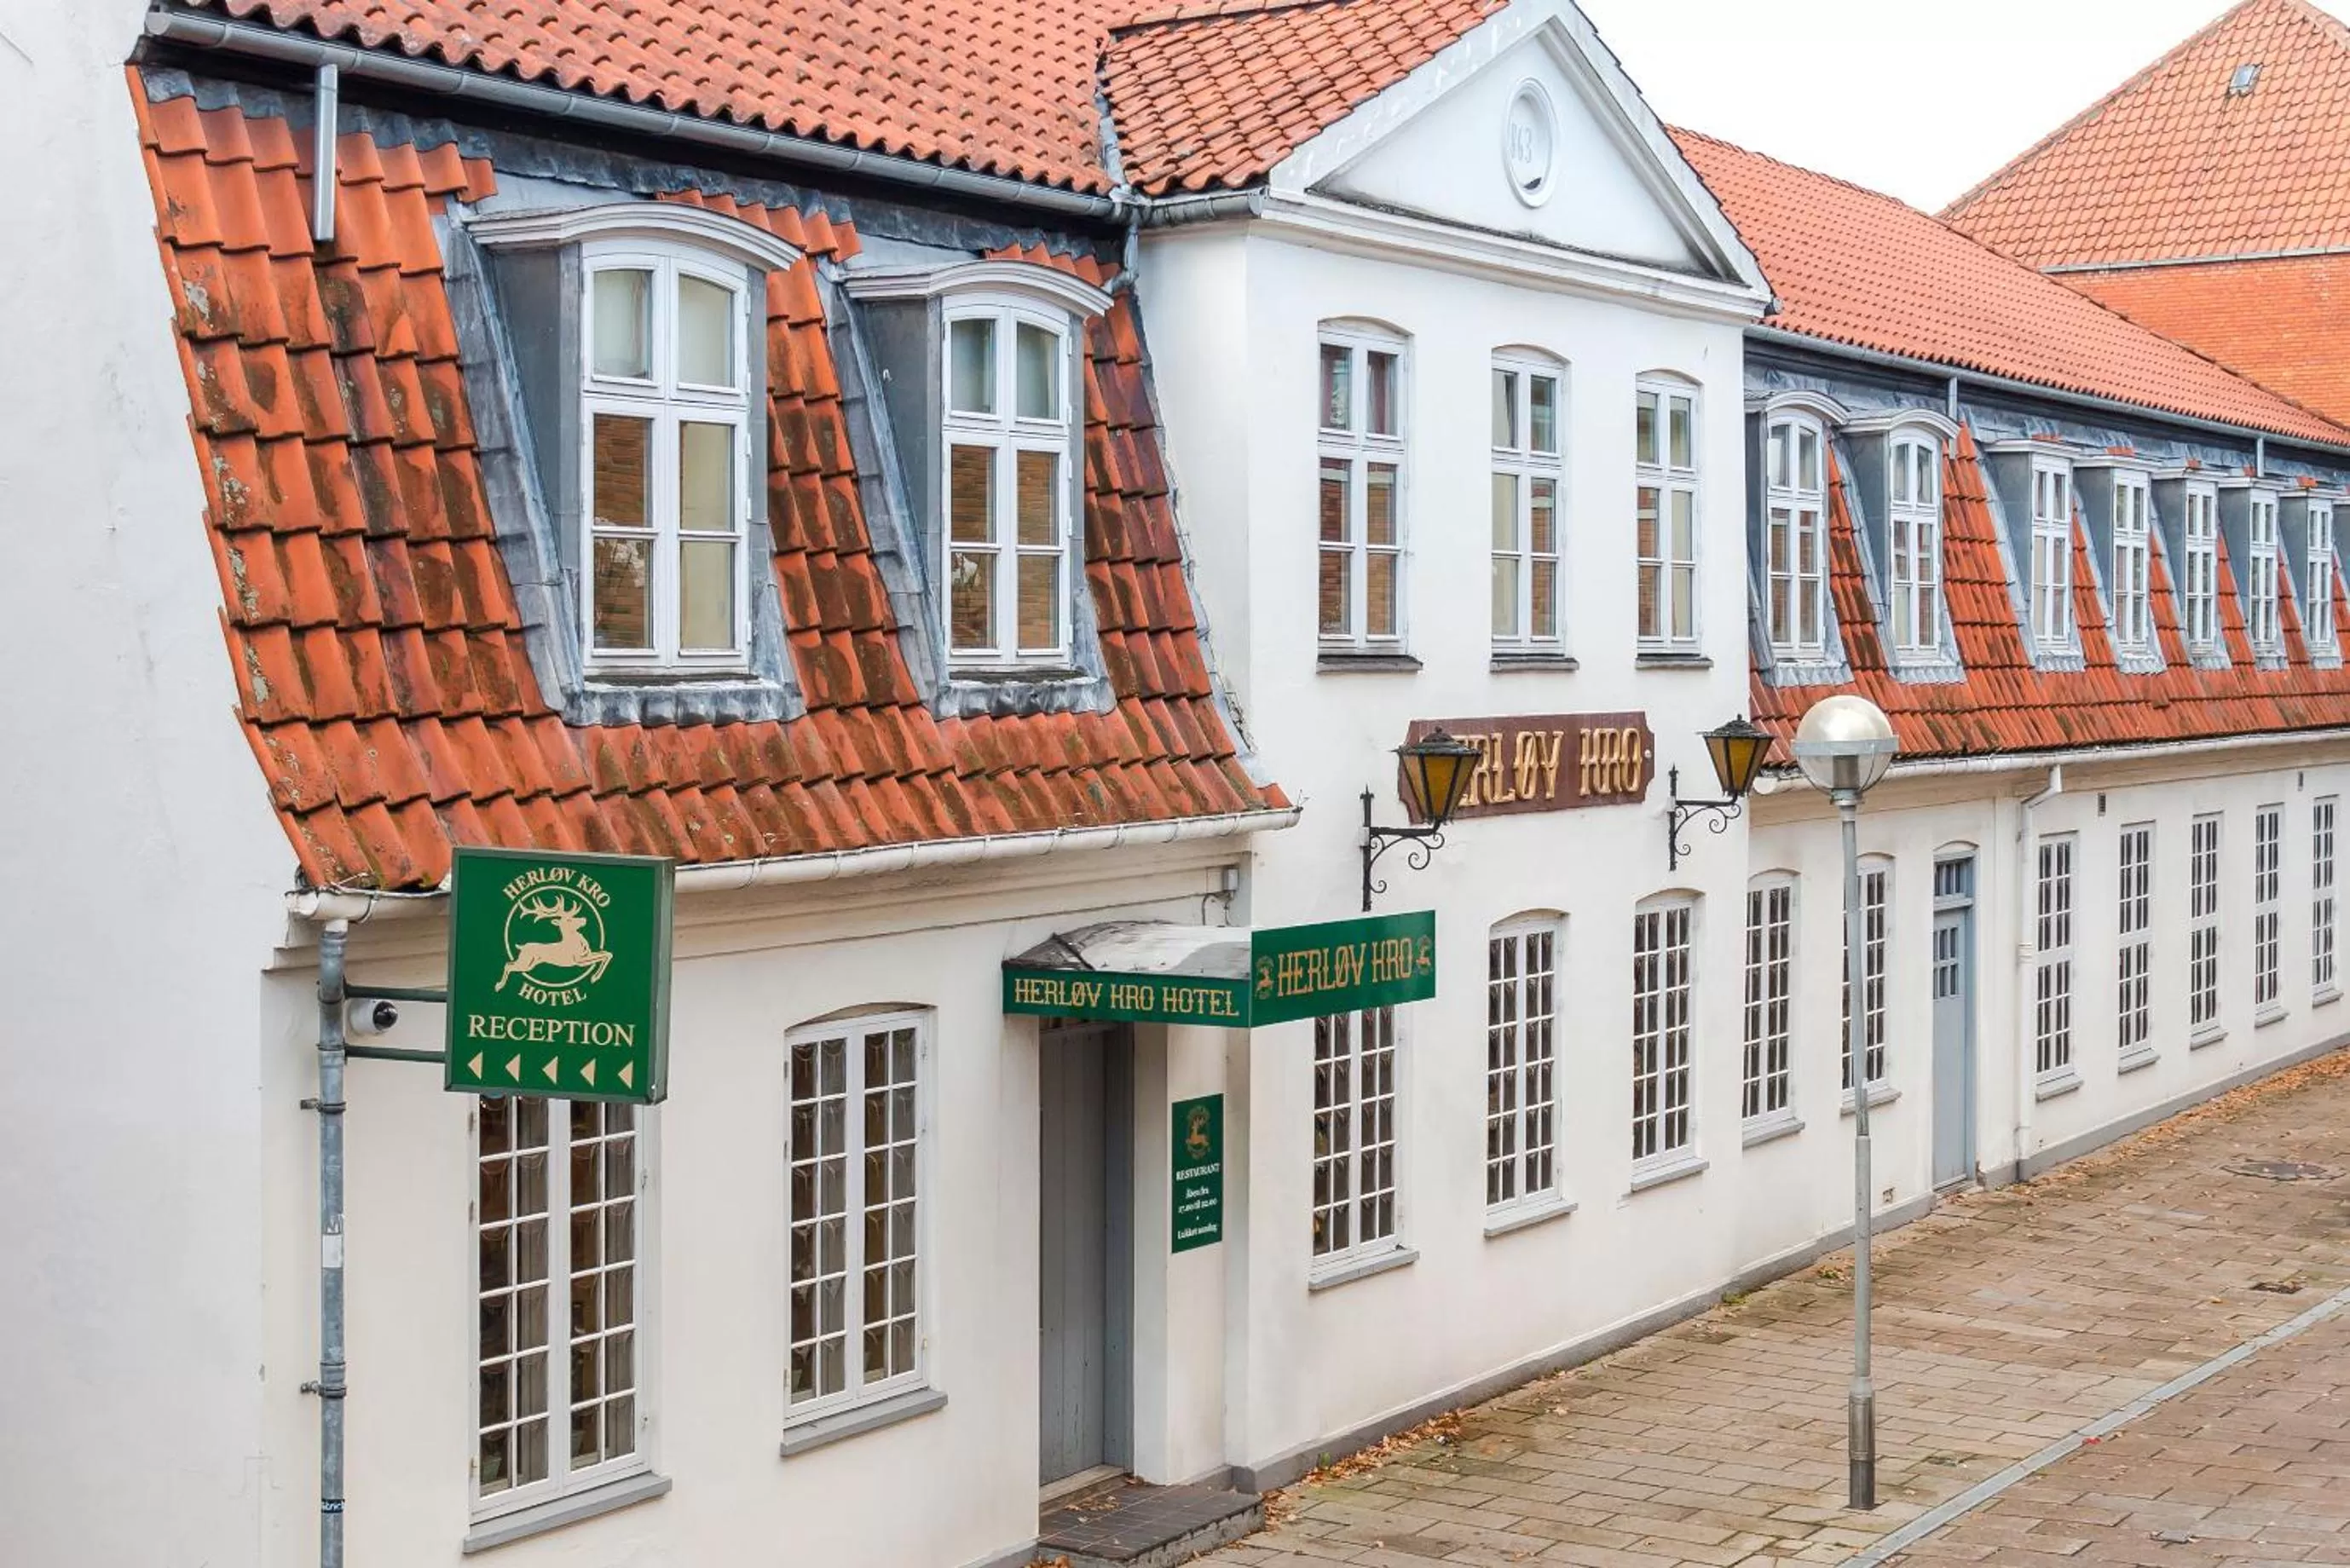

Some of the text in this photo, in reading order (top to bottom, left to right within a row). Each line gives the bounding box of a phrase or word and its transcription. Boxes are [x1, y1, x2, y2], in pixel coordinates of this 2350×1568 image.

[1452, 730, 1565, 807] RLØV
[502, 867, 611, 908] HERLØV KRO
[1277, 942, 1367, 998] HERLØV
[517, 982, 587, 1007] HOTEL
[1013, 977, 1104, 1008] HERLØV
[1162, 986, 1240, 1017] HOTEL
[467, 1014, 637, 1047] RECEPTION
[1175, 1162, 1221, 1182] RESTAURANT
